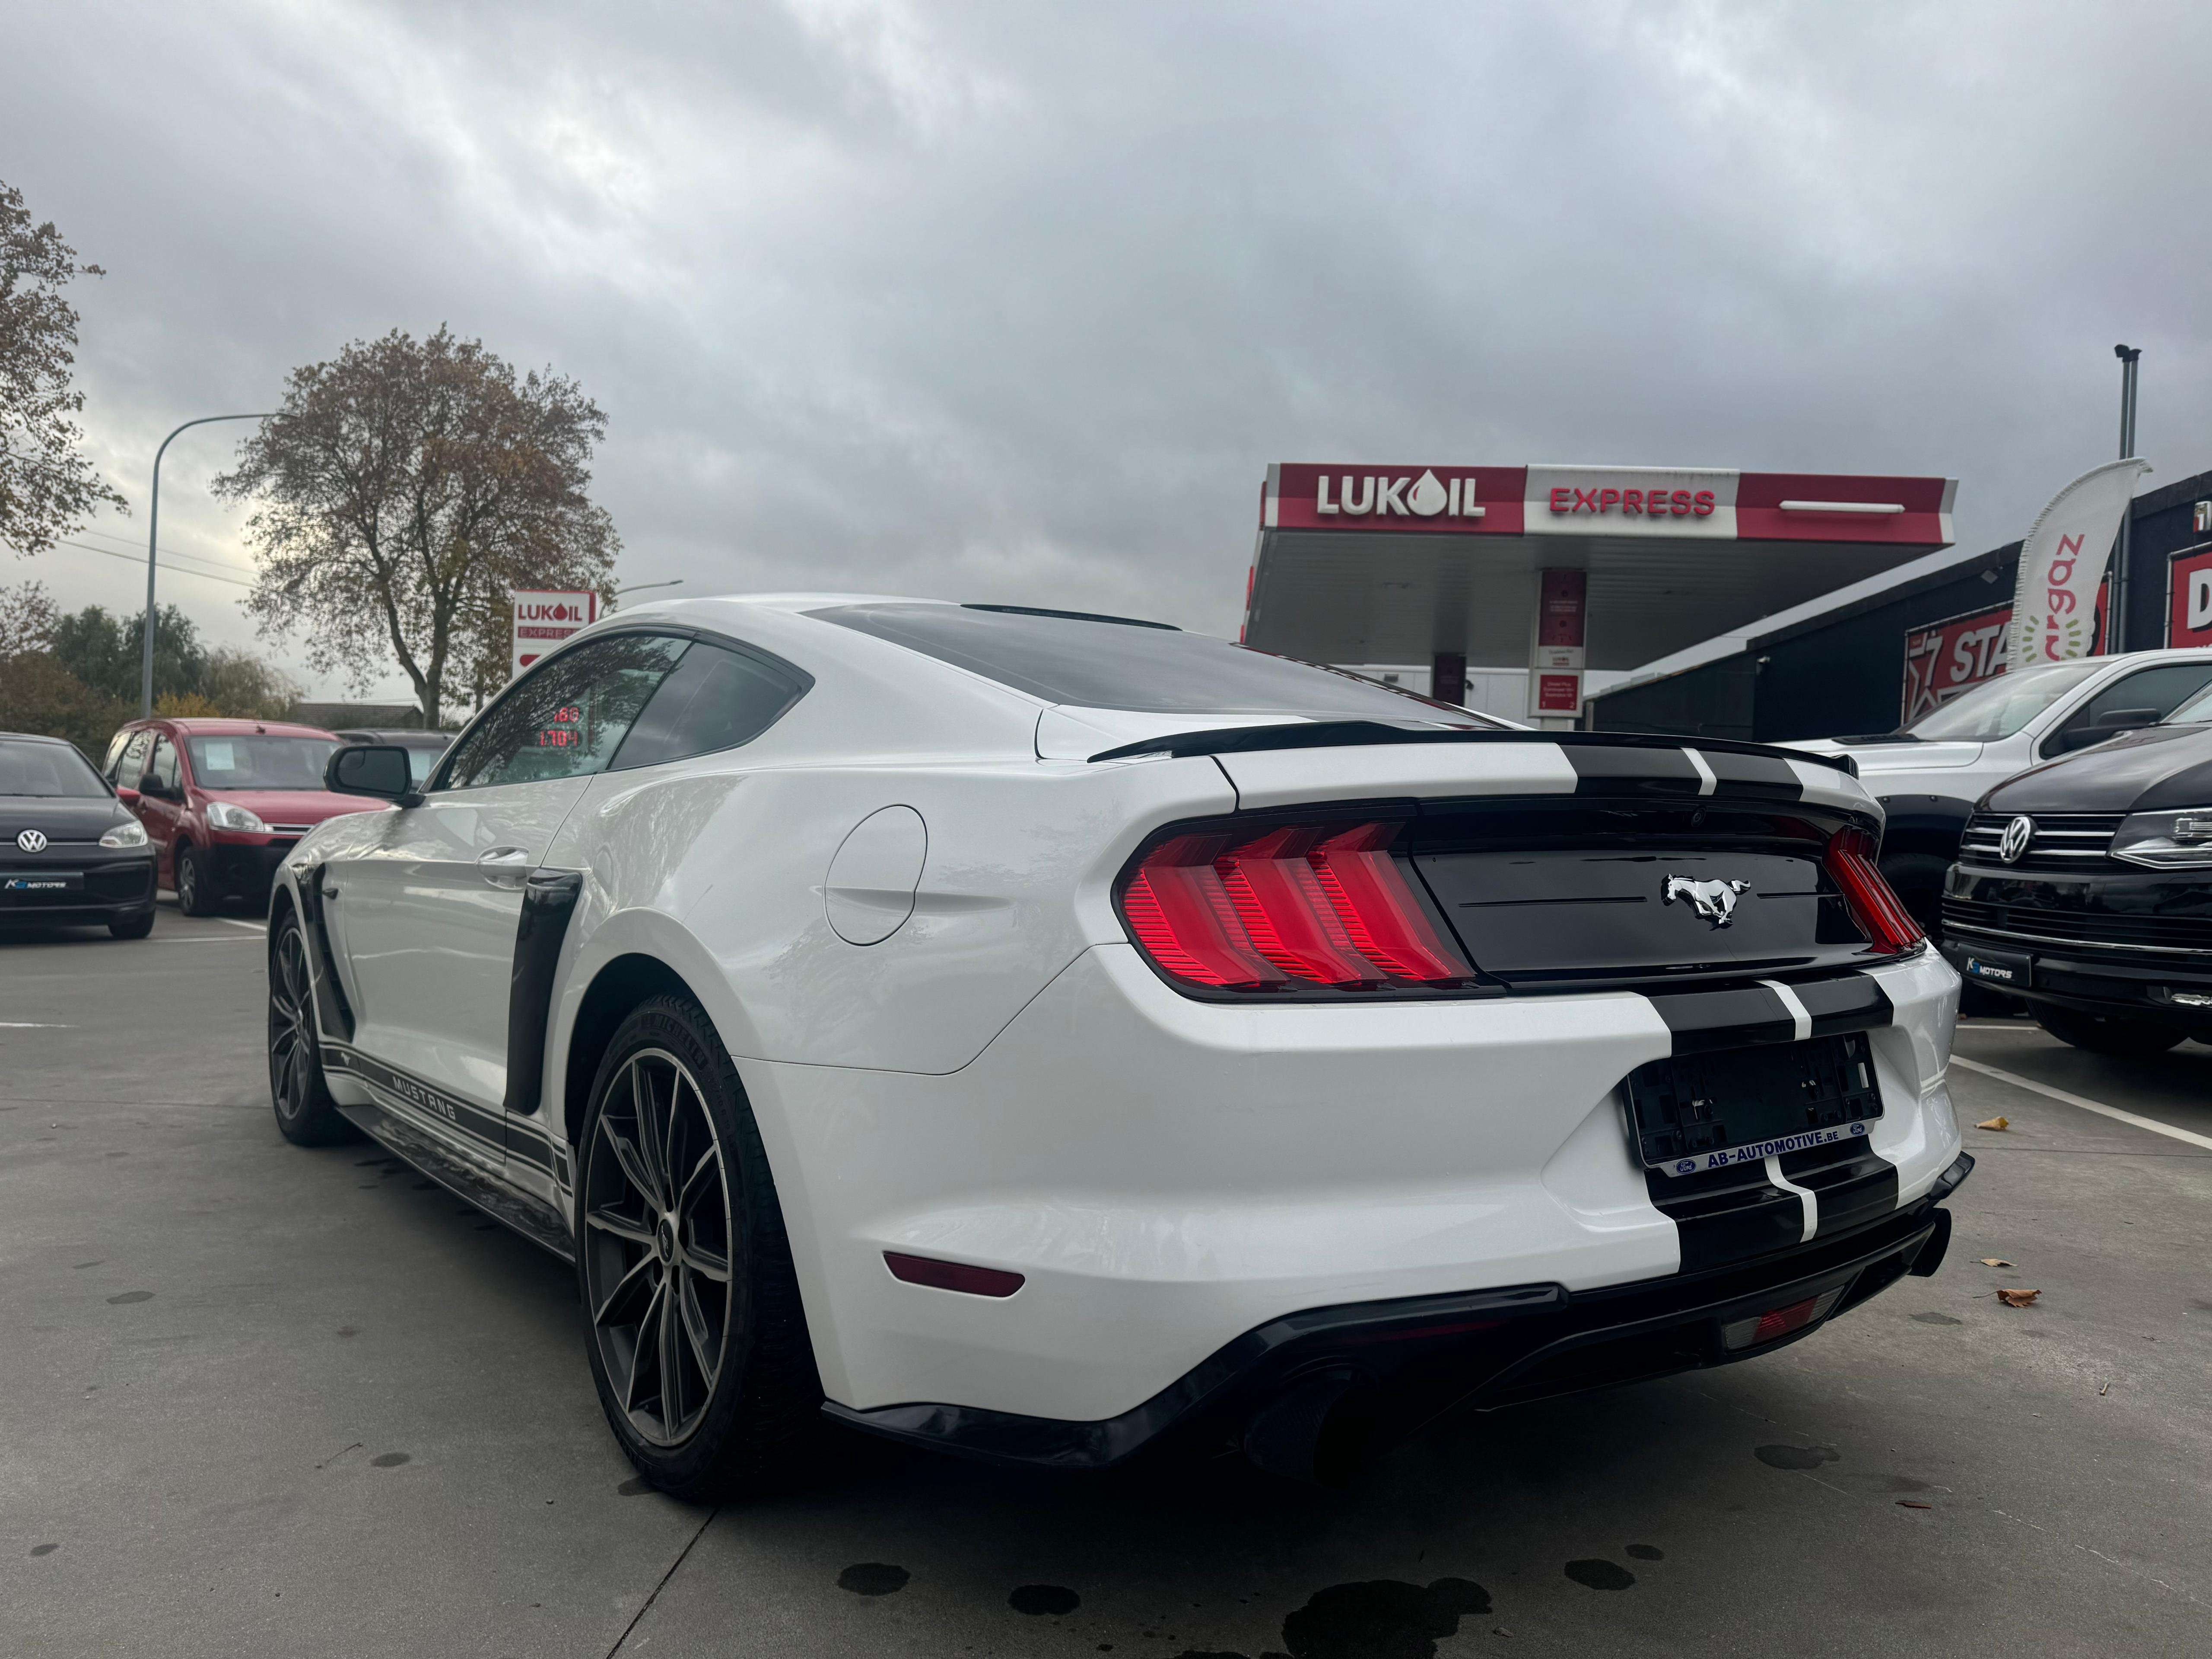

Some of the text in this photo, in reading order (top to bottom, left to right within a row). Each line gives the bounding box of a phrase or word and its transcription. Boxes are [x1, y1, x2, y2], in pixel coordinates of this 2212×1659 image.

[1317, 469, 1486, 517] LUKOIL
[1550, 488, 1715, 515] EXPRESS
[518, 603, 582, 622] LUKOIL
[1980, 966, 2012, 979] MOTORS
[393, 1075, 456, 1120] MUSTANG
[1679, 1161, 1693, 1172] Ford
[1708, 1131, 1839, 1168] AB-AUTOMOTIVE.BE
